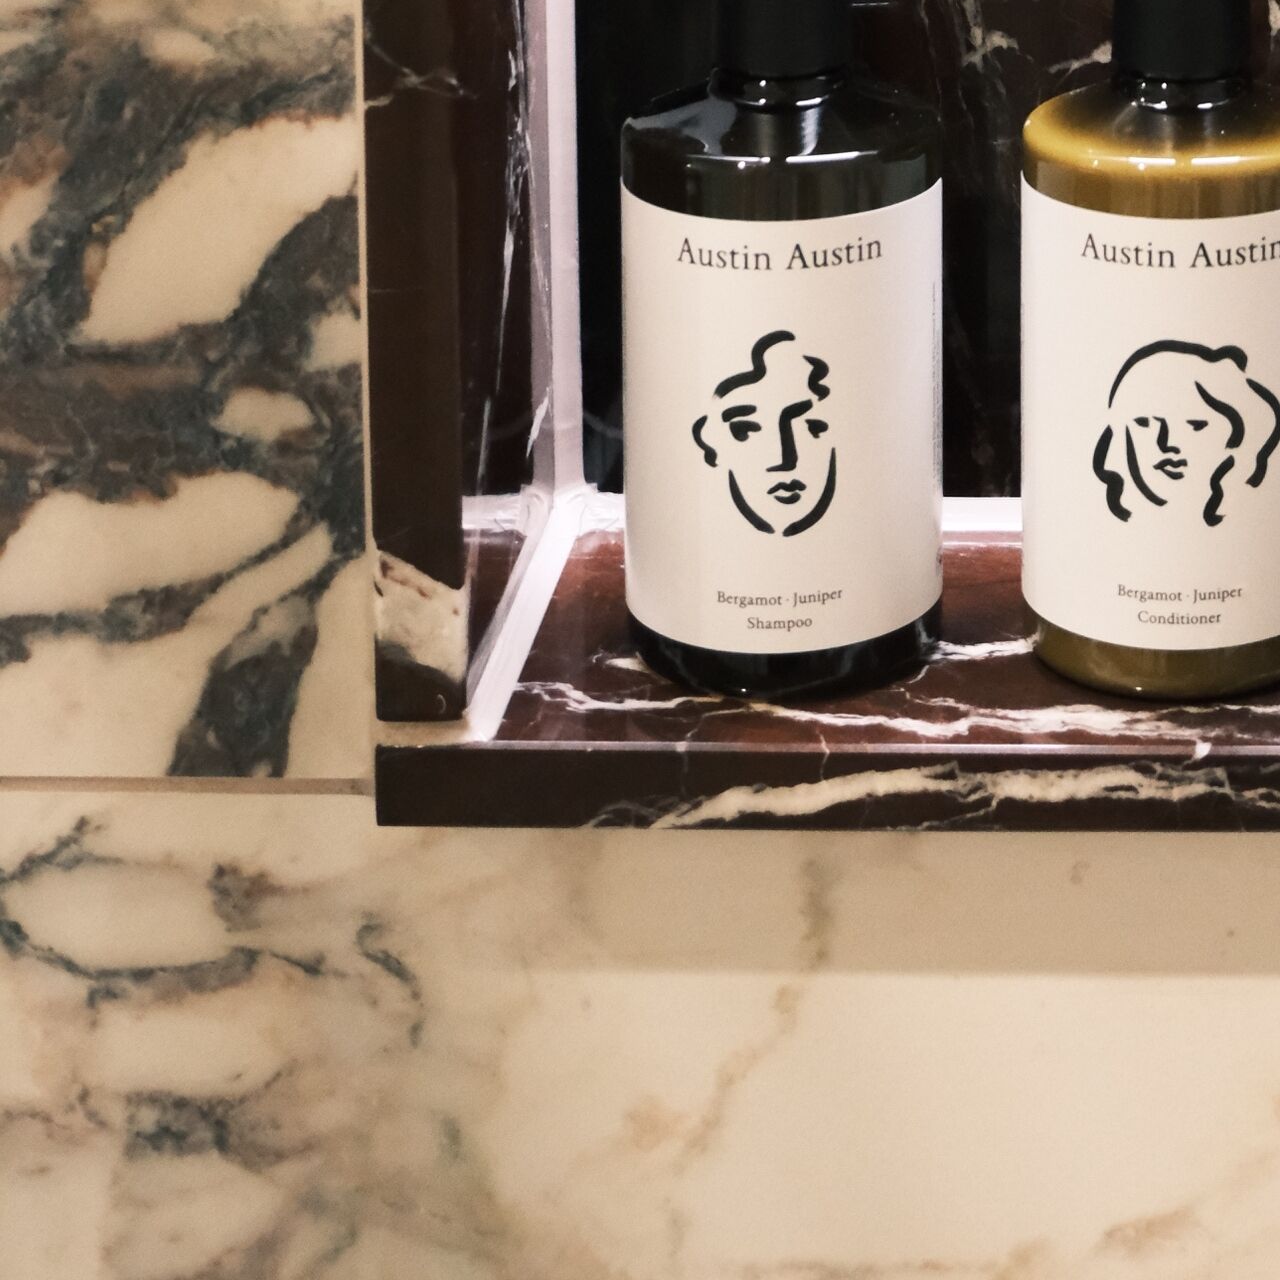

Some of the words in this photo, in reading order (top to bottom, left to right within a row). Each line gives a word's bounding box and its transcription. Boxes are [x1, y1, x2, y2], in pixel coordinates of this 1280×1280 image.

[677, 236, 772, 272] Austin
[785, 235, 882, 271] Austin
[1081, 231, 1176, 269] Austin
[717, 590, 782, 608] Bergamot
[793, 589, 843, 608] Juniper
[1117, 584, 1183, 603] Bergamot
[1193, 587, 1242, 604] Juniper
[747, 616, 813, 632] Shampoo
[1137, 609, 1222, 625] Conditioner
